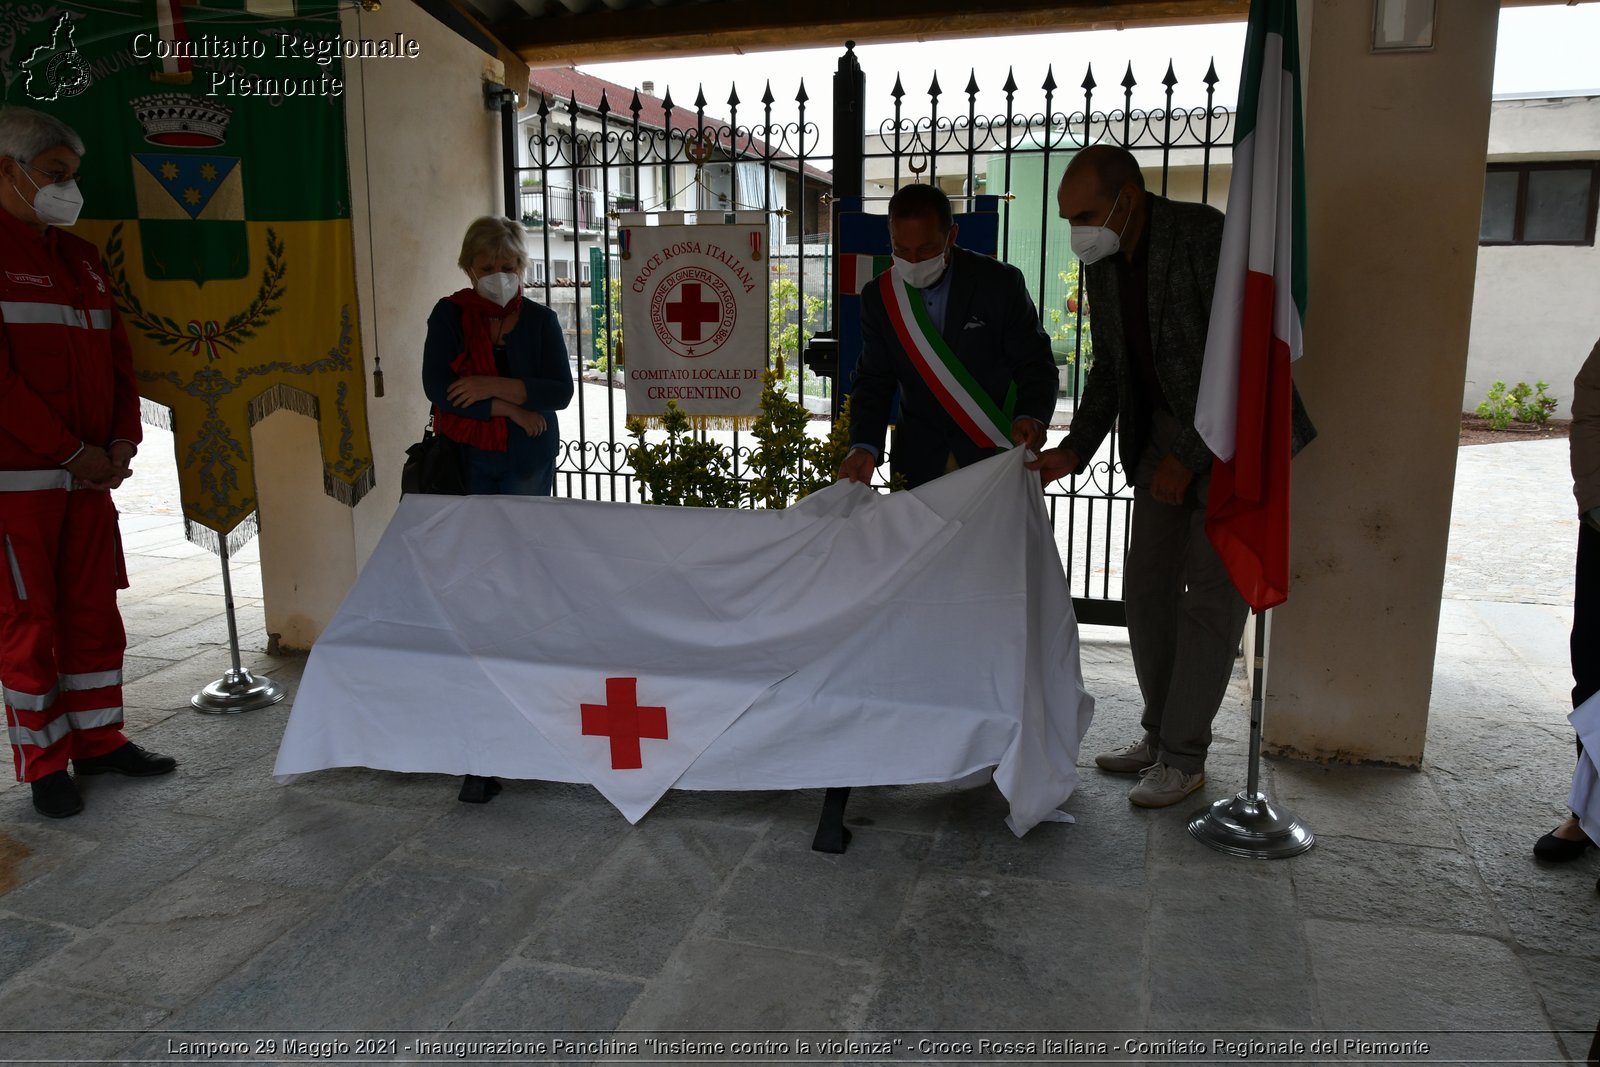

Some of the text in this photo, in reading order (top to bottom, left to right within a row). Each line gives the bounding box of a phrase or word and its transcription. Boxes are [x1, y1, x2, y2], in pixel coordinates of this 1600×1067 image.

[632, 241, 755, 293] CROCE ROSSA ITALIANA
[653, 270, 734, 345] CONVENZIONE DI GINEVRA 22 AGOSTO 1864
[631, 369, 757, 381] COMITATO LOCALE DI
[647, 386, 741, 400] CRESCENTINO
